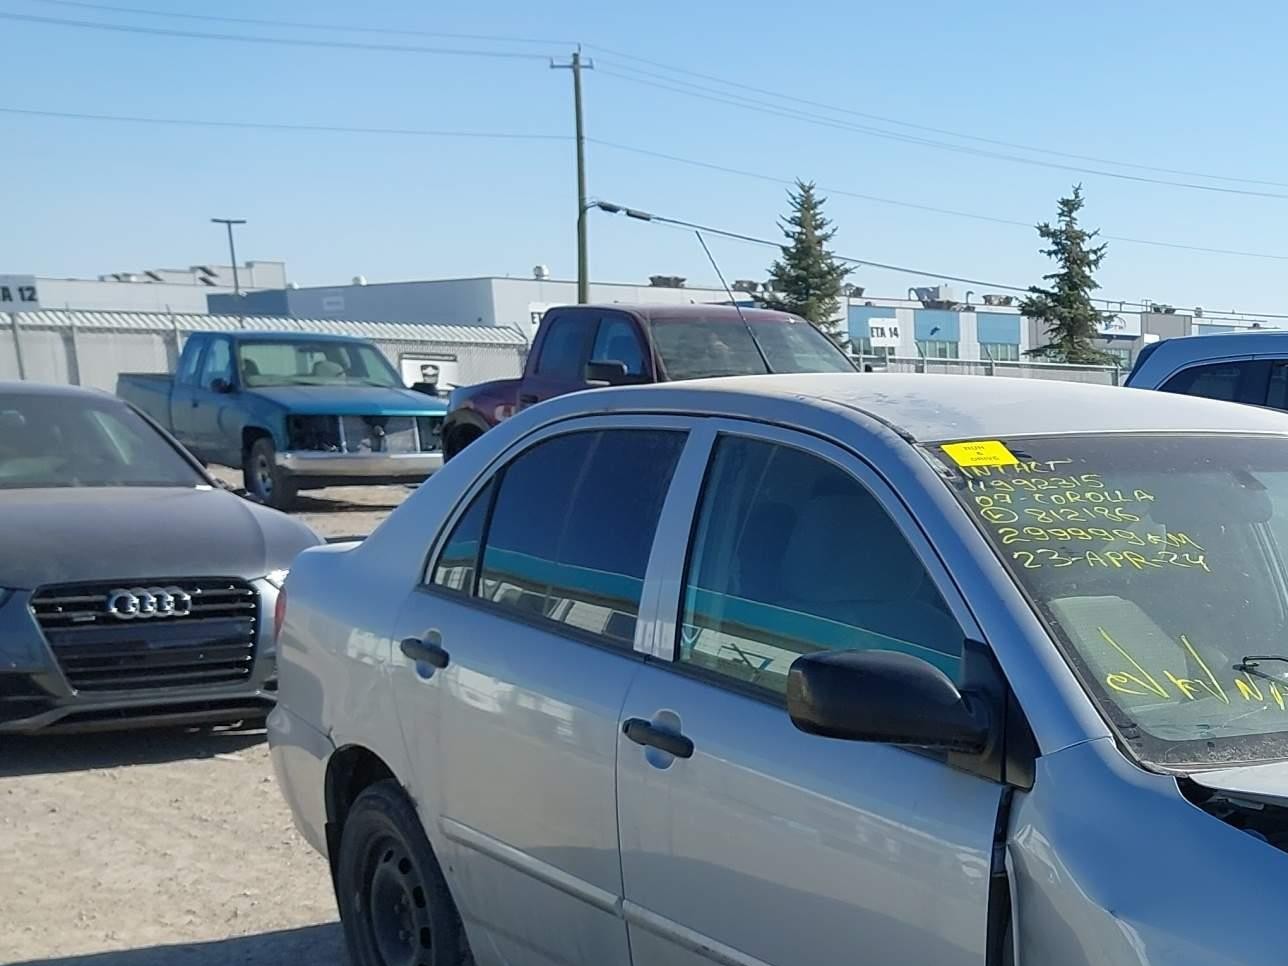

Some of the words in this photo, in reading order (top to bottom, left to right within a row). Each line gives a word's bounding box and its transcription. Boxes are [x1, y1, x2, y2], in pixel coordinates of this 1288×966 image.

[18, 286, 38, 302] 12
[870, 326, 886, 338] ETA
[889, 326, 899, 338] 14
[968, 475, 1104, 493] 11992315
